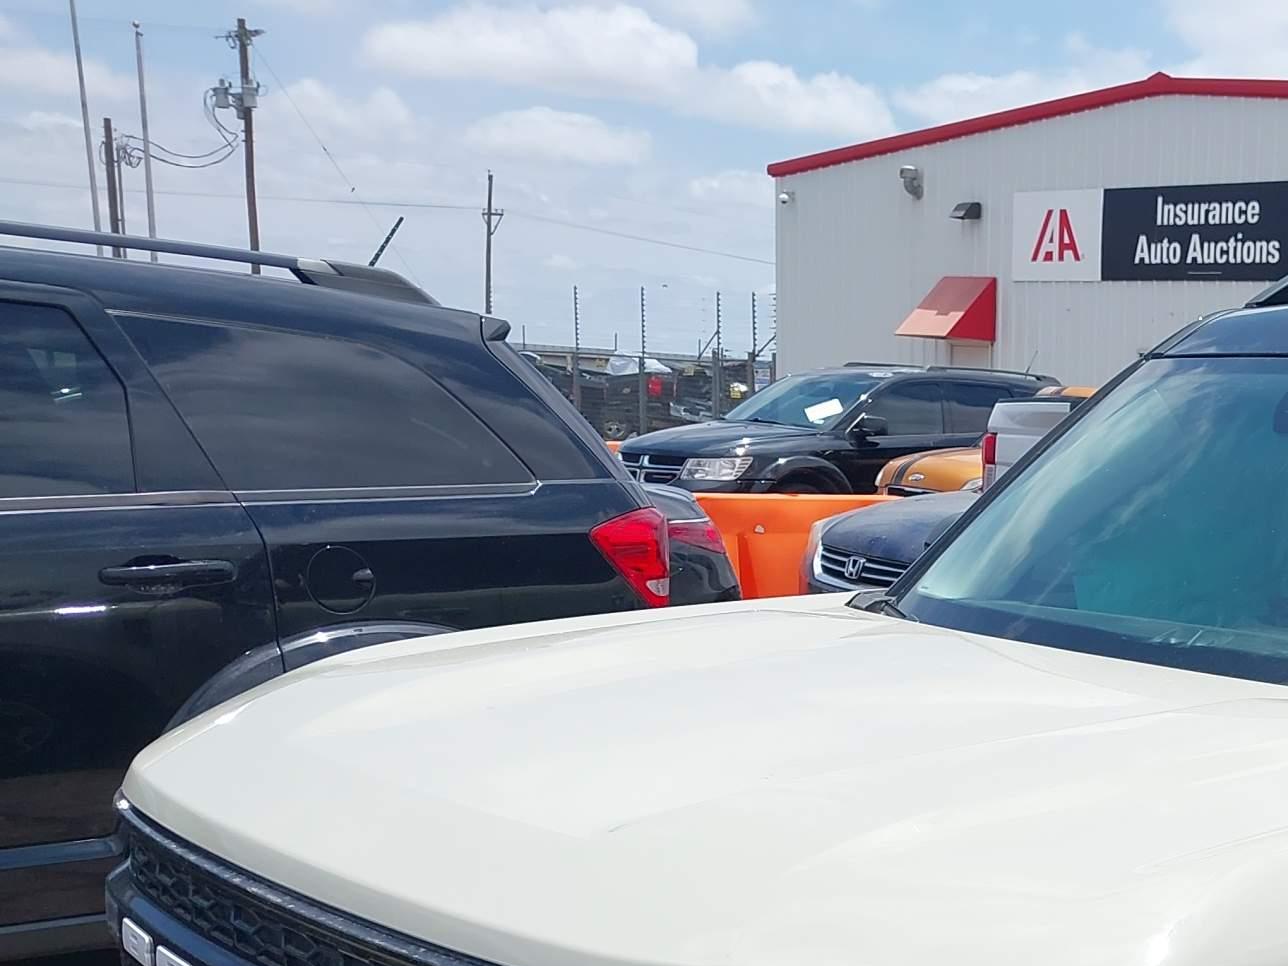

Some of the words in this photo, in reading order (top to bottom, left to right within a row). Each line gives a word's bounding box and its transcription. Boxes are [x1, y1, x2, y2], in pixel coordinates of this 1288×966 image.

[1156, 196, 1260, 227] Insurance
[1134, 234, 1181, 265] Auto
[1185, 232, 1281, 265] Auctions
